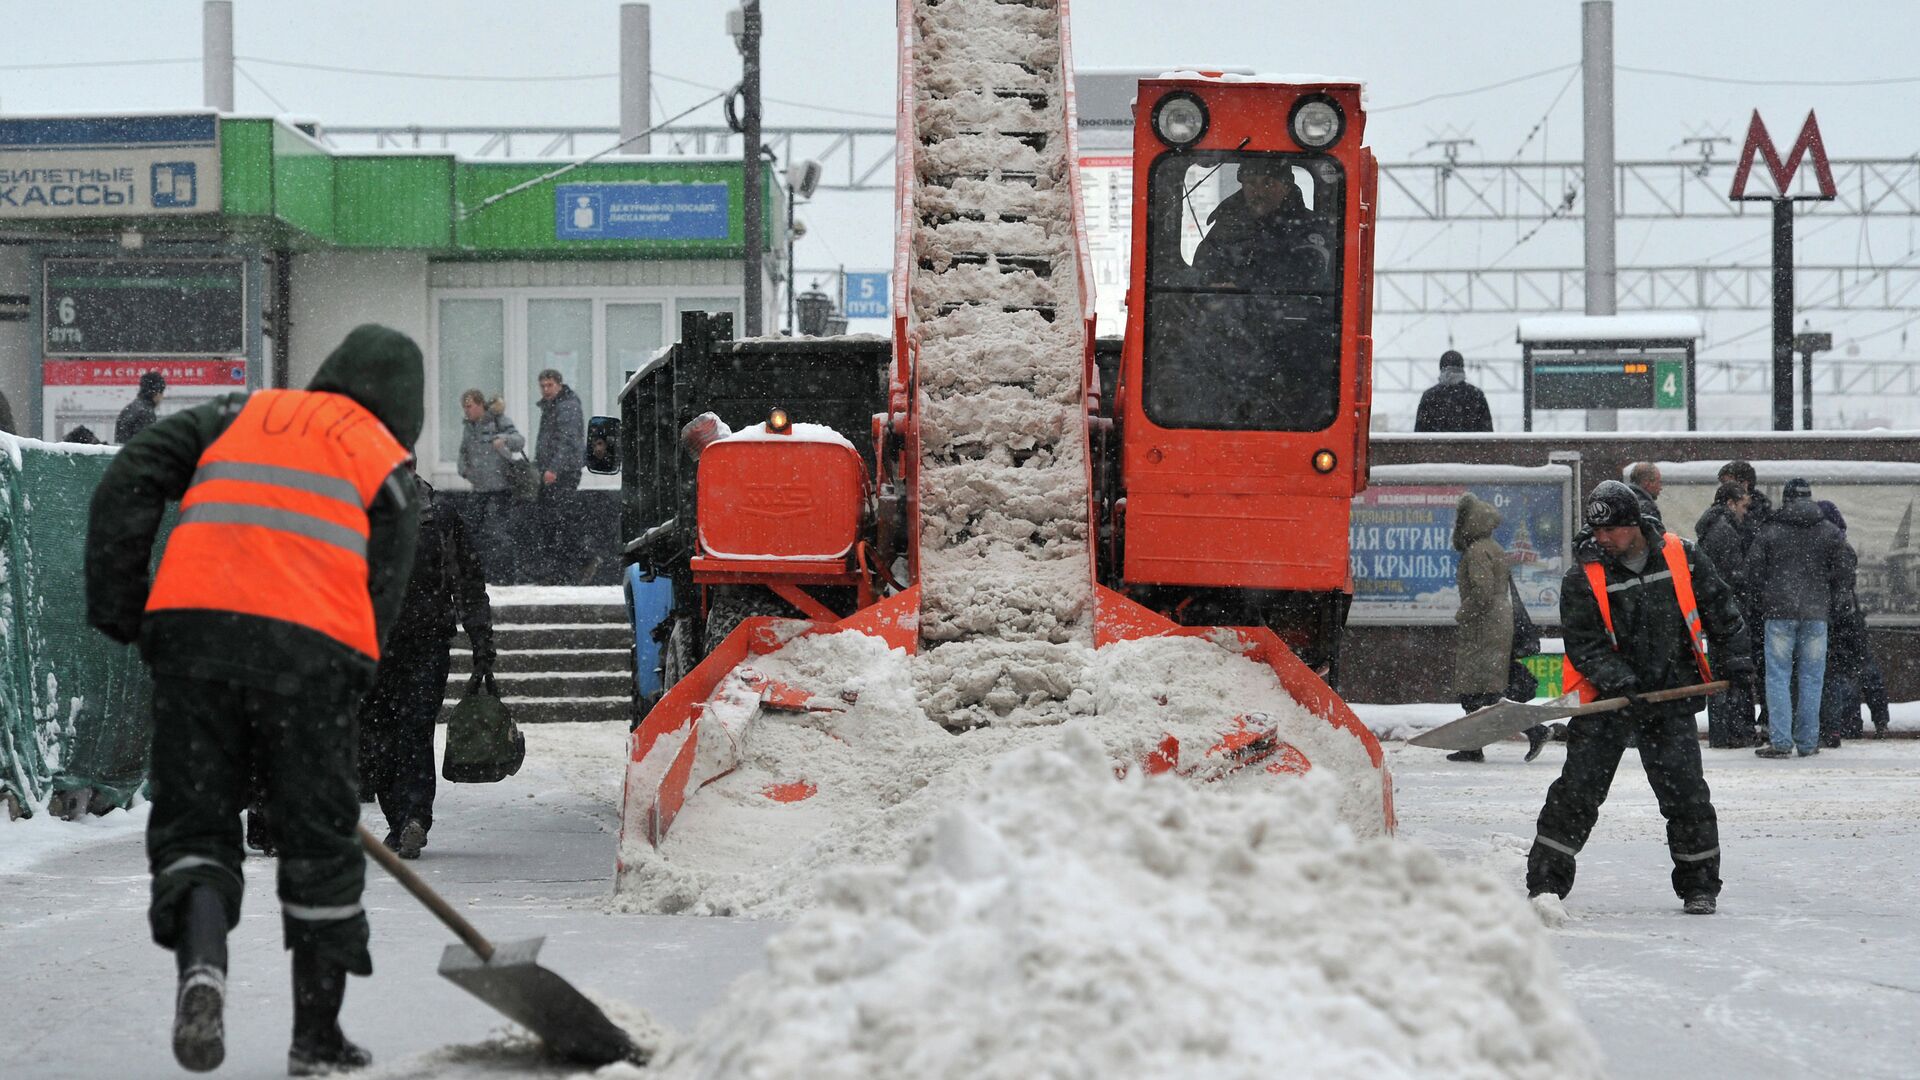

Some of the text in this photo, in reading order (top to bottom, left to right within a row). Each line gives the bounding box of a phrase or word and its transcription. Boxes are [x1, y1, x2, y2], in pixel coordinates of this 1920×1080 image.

[1729, 107, 1838, 196] М
[0, 167, 134, 184] БИЛЕТНЫЕ
[0, 185, 134, 208] КАССЫ
[859, 278, 875, 299] 5
[59, 296, 75, 324] 6
[1662, 373, 1677, 398] 4
[1494, 493, 1511, 508] 0+
